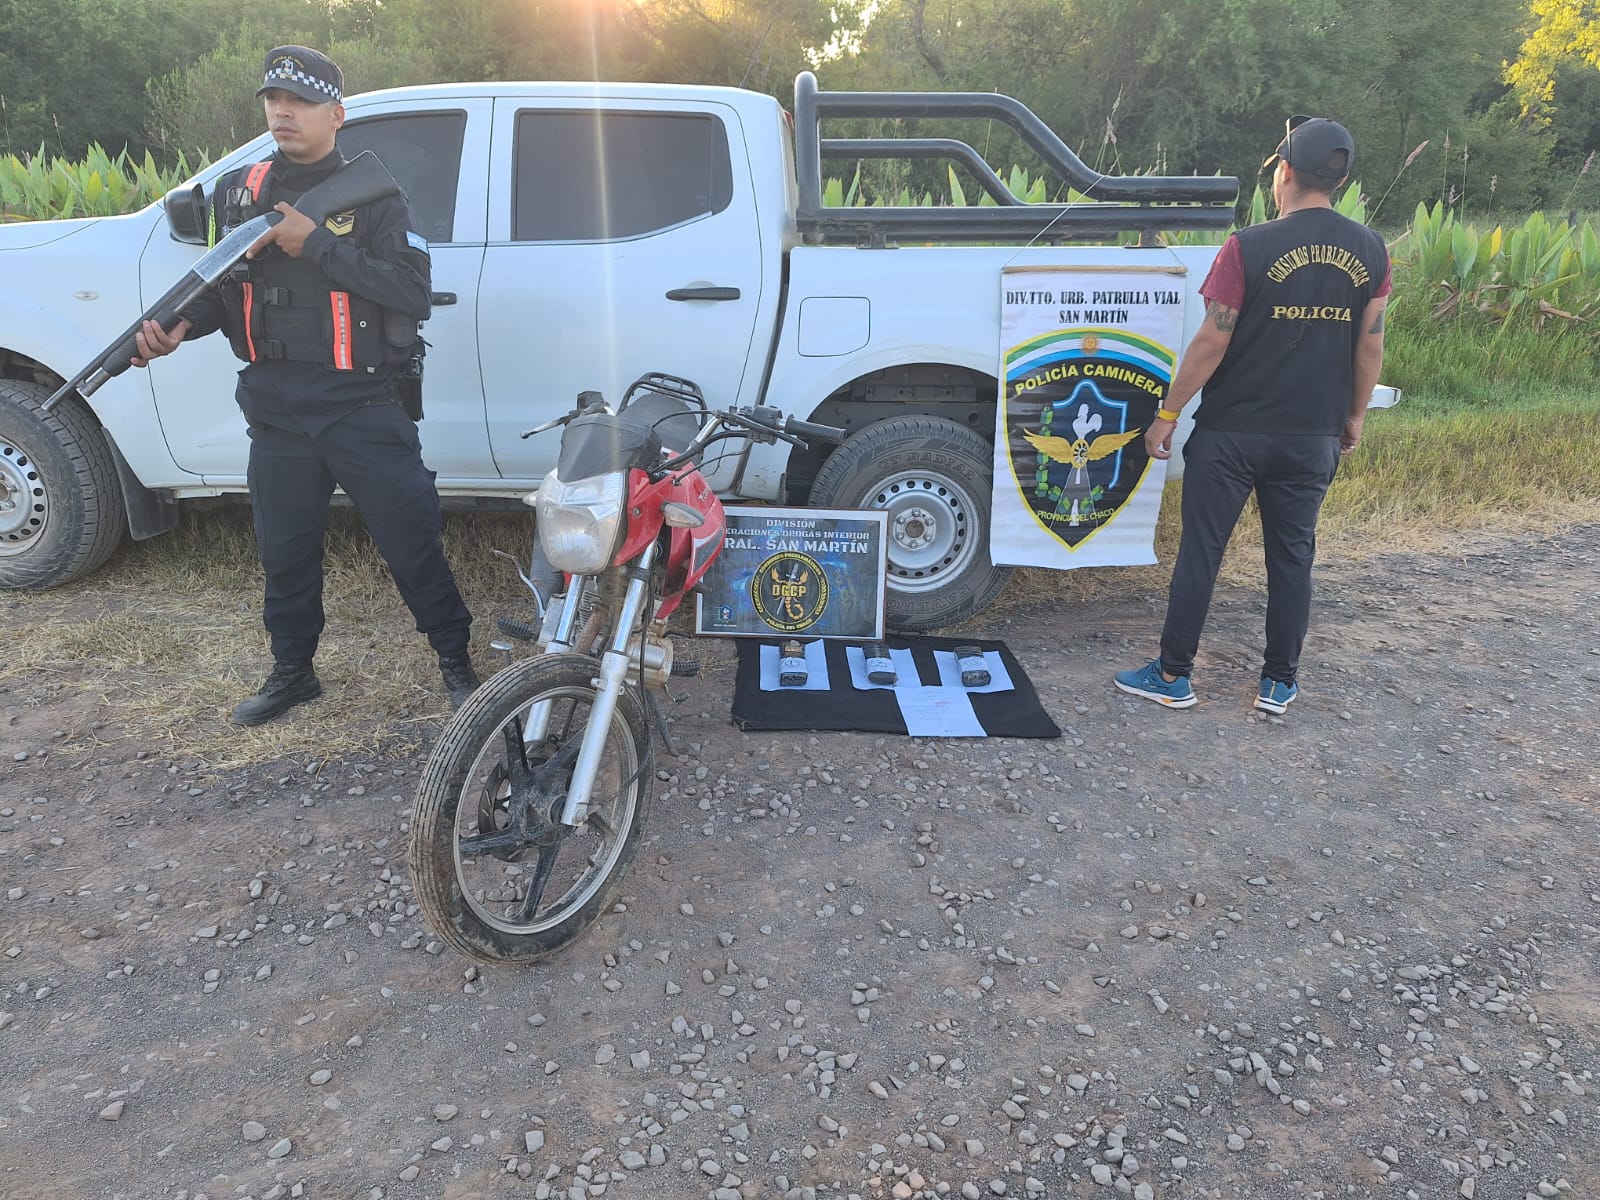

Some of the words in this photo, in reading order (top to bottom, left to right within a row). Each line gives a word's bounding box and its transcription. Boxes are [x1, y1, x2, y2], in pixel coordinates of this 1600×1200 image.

[1266, 245, 1310, 283] CONSUMOS
[1006, 291, 1056, 305] DIV.TTO.
[1060, 291, 1088, 305] URB.
[1092, 291, 1149, 305] PATRULLA
[1154, 291, 1181, 305] VIAL
[1059, 309, 1080, 324] SAN
[1083, 307, 1129, 324] MARTÍN
[1271, 305, 1352, 322] POLICIA
[1014, 363, 1079, 396] POLICÍA
[1083, 363, 1164, 398] CAMINERA
[766, 518, 816, 529] DIVISIÓN
[1037, 510, 1073, 523] PROVINCIA
[1089, 508, 1114, 520] CHACO
[782, 530, 822, 539] DROGAS
[823, 531, 870, 541] INTERIOR
[723, 537, 761, 551] RAL.
[766, 539, 799, 551] SAN
[803, 538, 868, 554] MARTÍN
